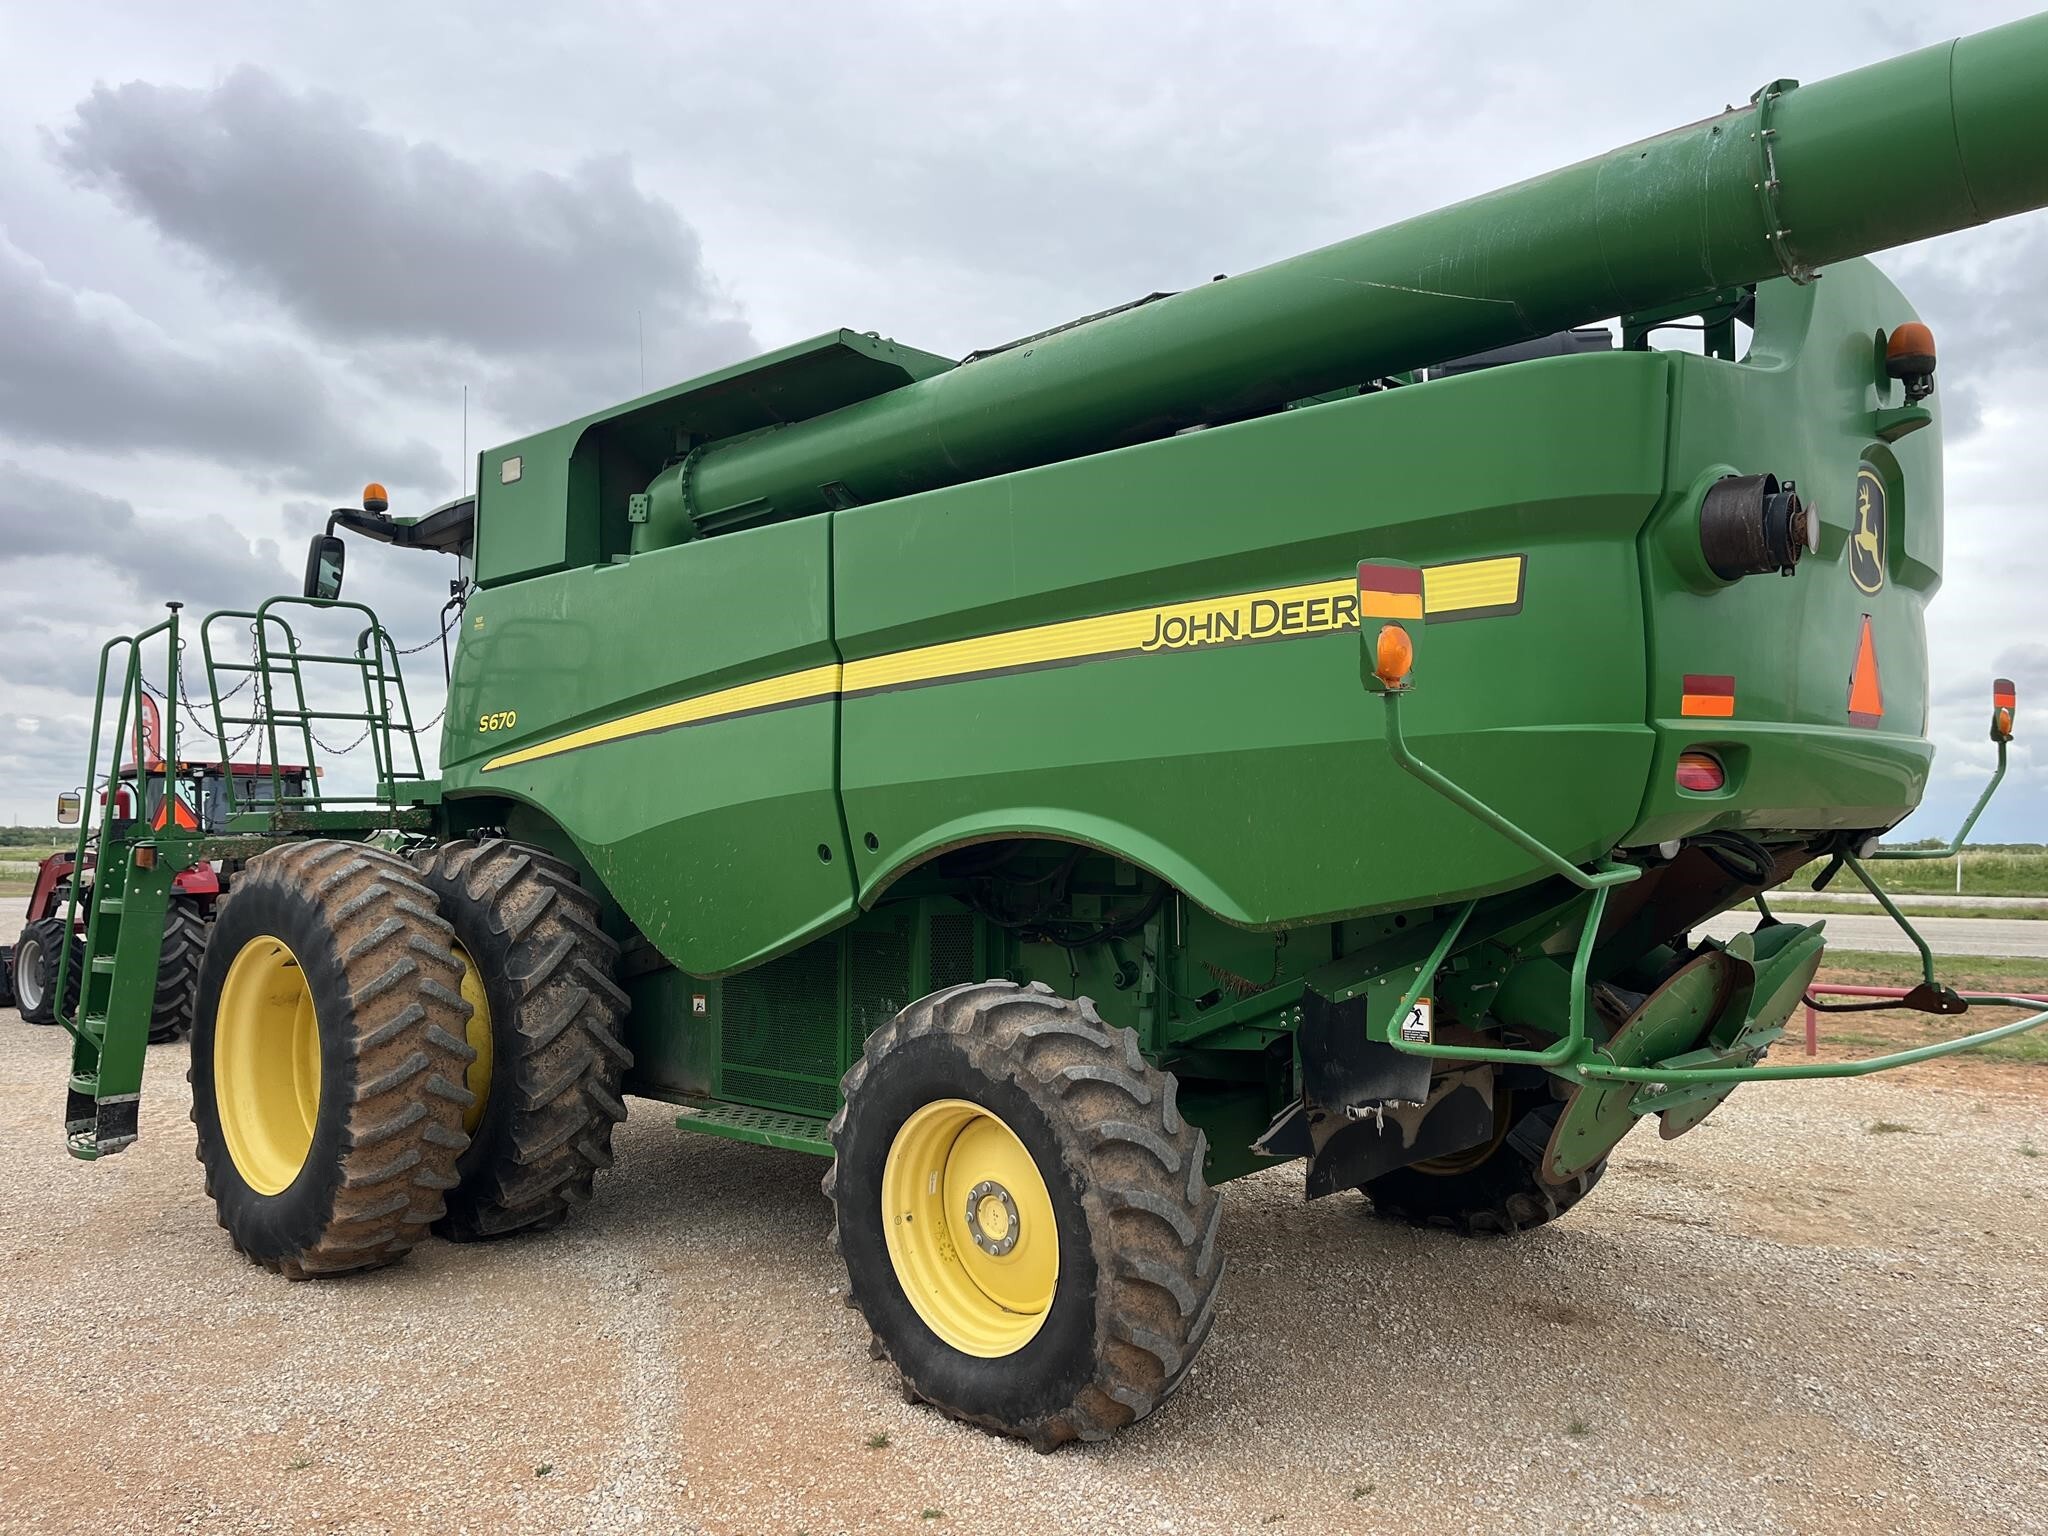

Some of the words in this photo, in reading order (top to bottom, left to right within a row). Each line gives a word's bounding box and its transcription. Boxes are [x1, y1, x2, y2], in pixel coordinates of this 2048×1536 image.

[1142, 609, 1241, 649] JOHN
[1251, 594, 1359, 635] DEER
[478, 710, 517, 733] S670
